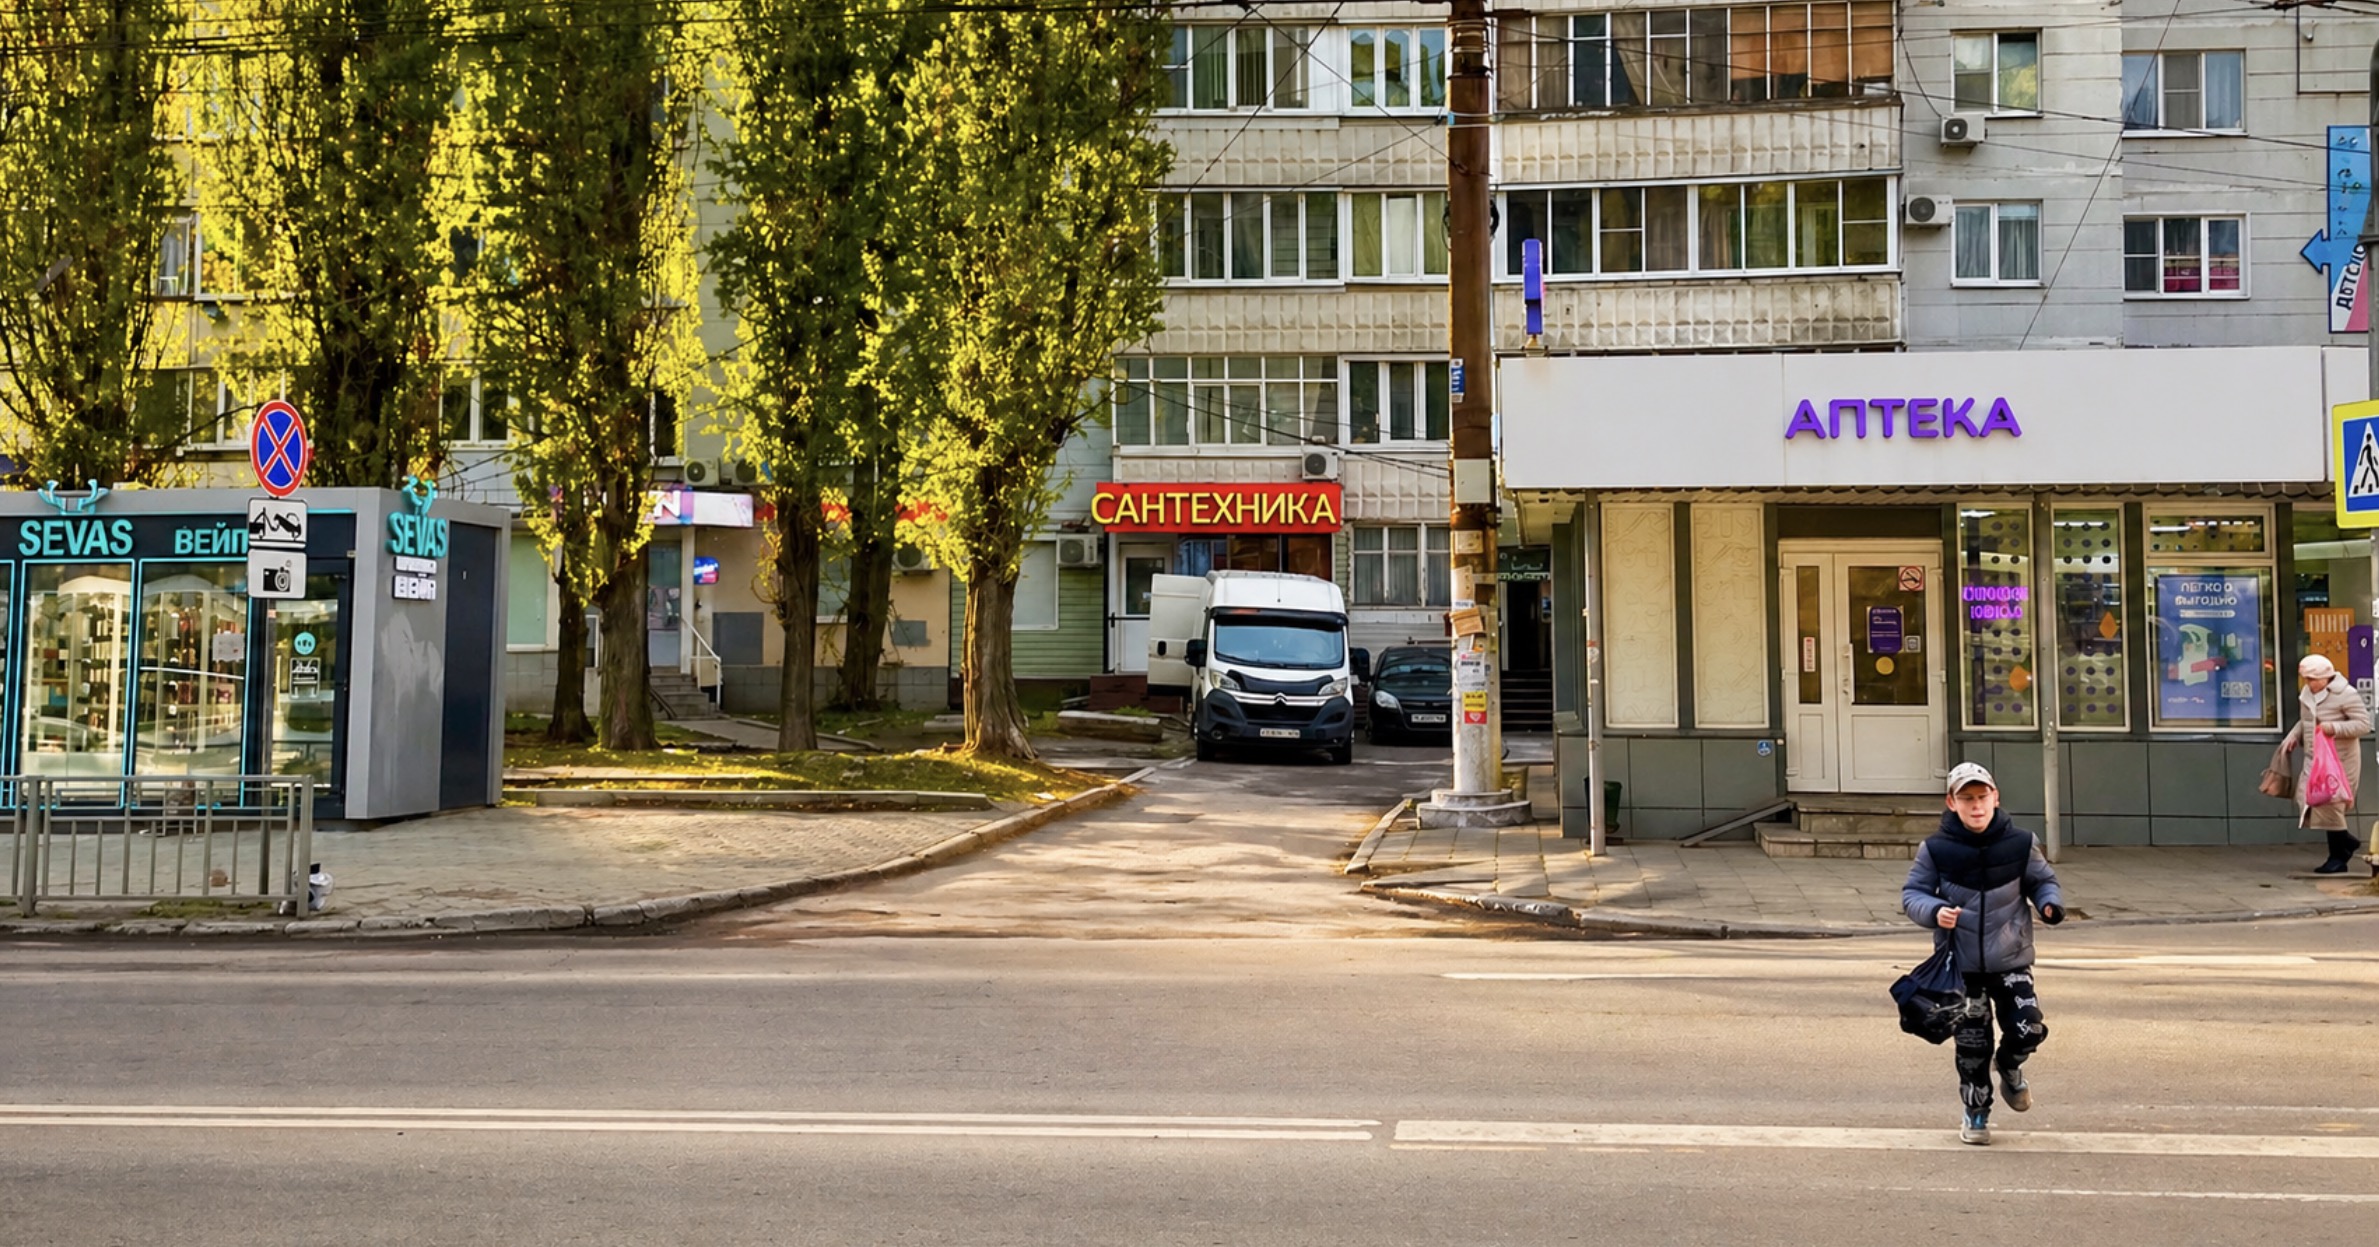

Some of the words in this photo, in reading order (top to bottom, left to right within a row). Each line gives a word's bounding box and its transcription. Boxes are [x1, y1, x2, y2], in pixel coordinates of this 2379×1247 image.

[1785, 397, 2022, 439] АПТЕКА
[1091, 492, 1337, 525] САНТЕХНИКА
[18, 519, 133, 556] SEVAS
[174, 521, 249, 555] ВЕЙП
[386, 511, 448, 559] SEVAS
